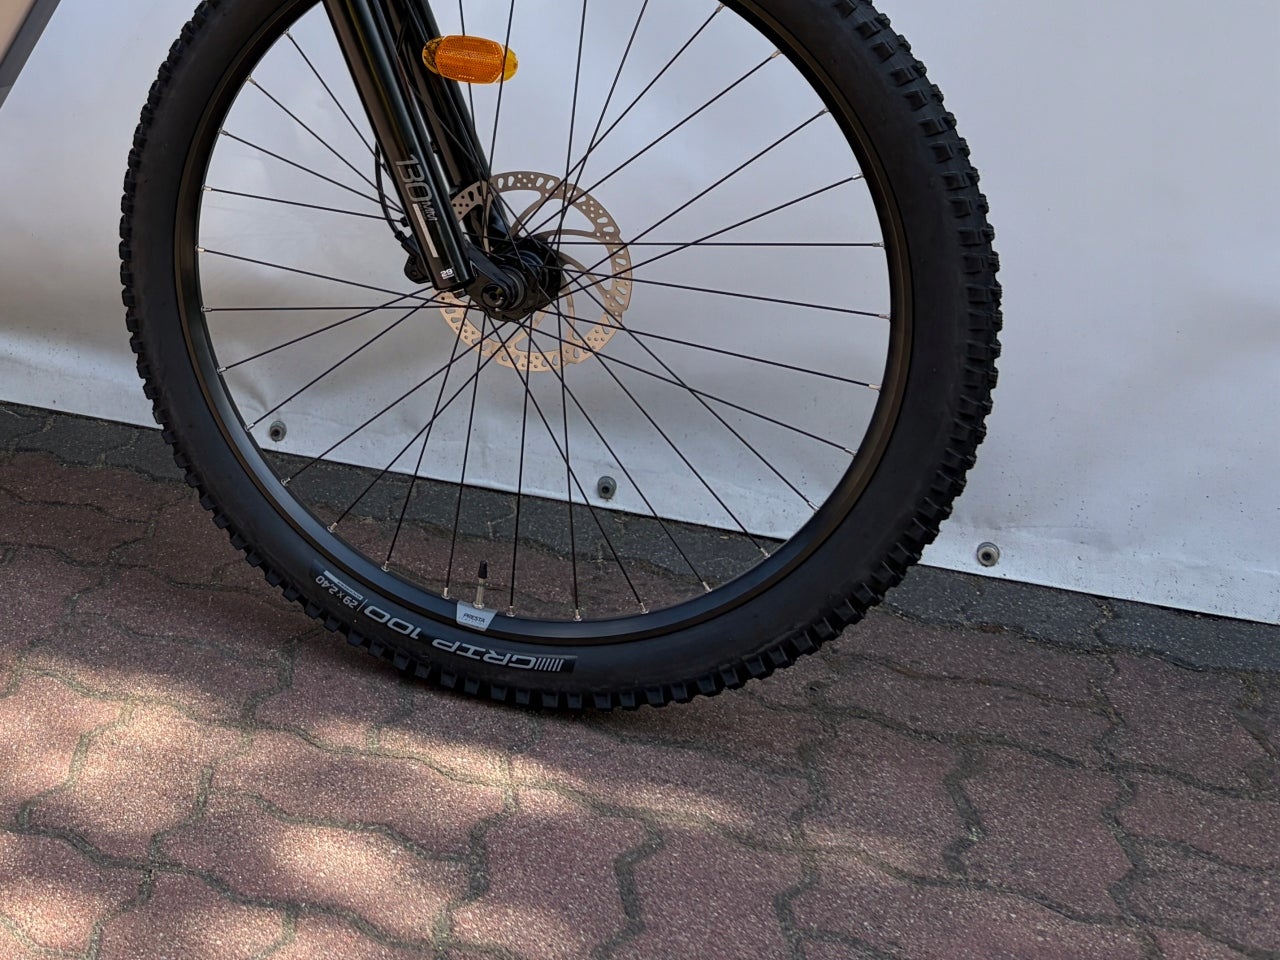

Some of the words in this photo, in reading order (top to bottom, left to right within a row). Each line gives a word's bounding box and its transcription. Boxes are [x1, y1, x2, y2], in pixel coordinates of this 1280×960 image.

[342, 595, 359, 609] 29
[363, 605, 422, 640] 100
[431, 638, 538, 670] GRIP
